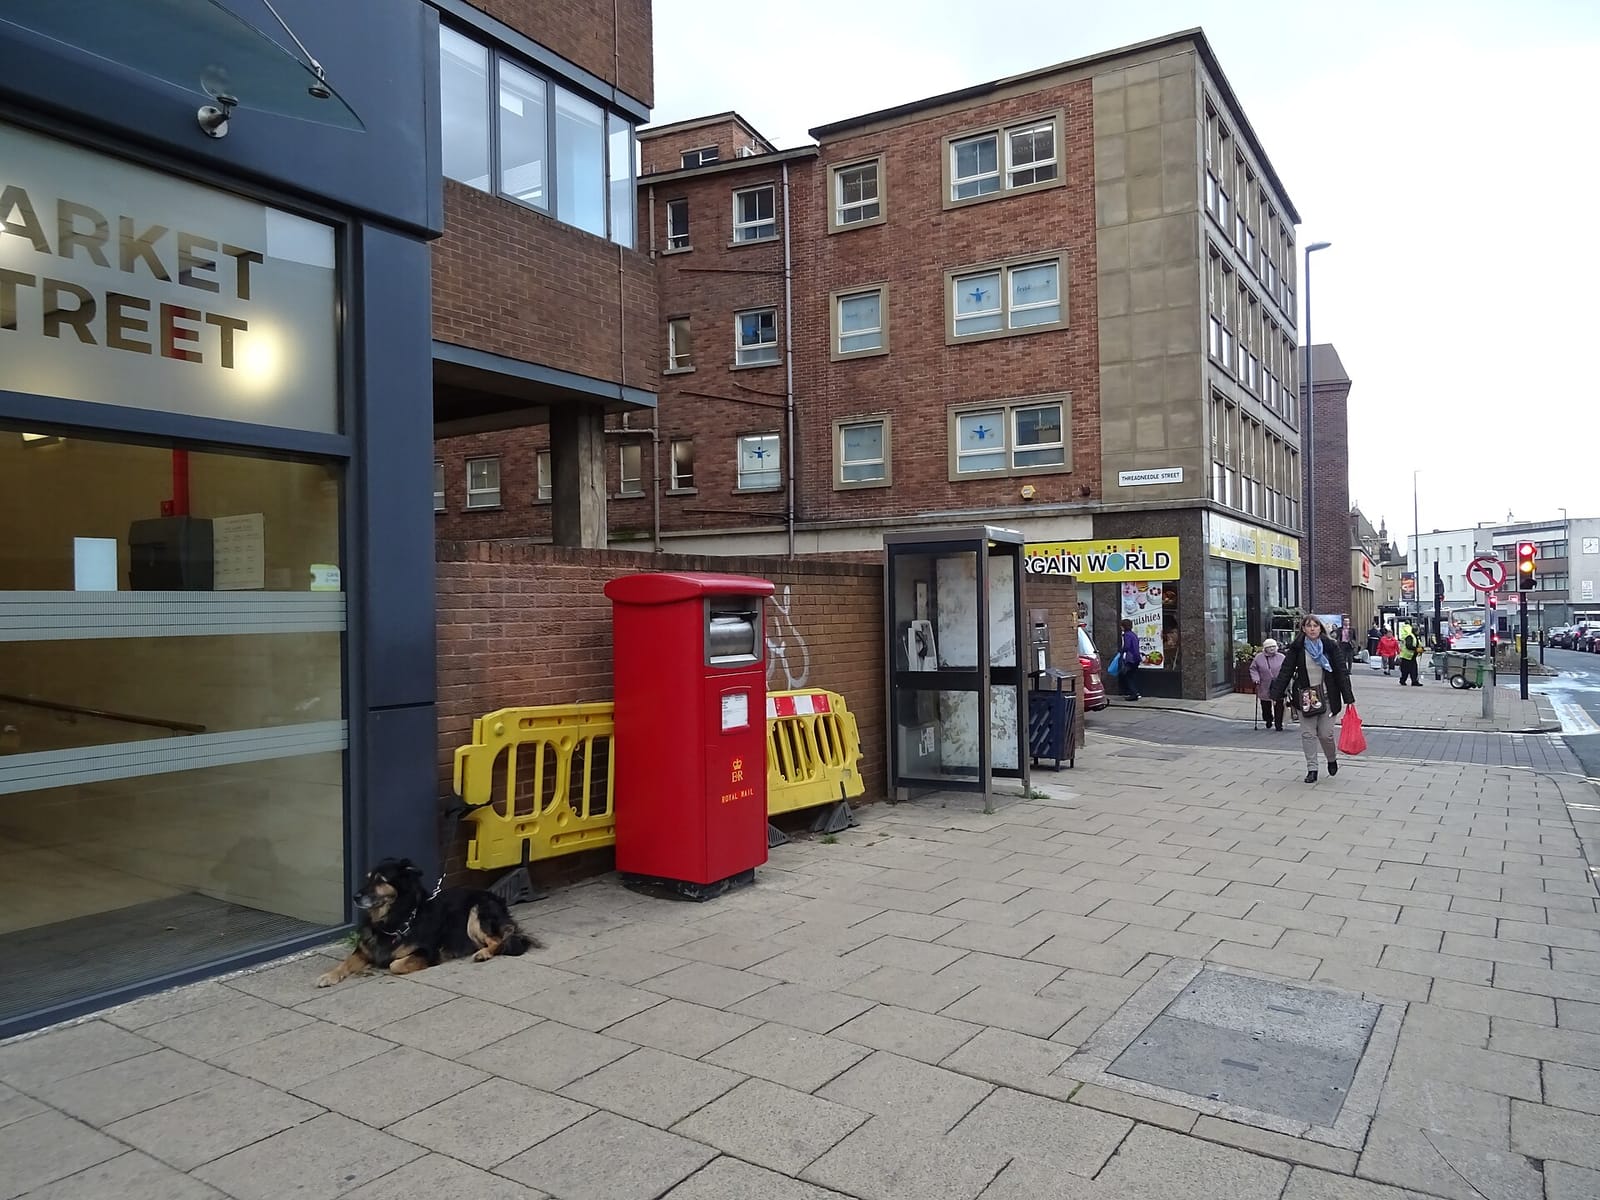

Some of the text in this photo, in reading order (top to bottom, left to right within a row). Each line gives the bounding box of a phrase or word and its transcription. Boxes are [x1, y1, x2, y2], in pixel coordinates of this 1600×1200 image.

[1121, 471, 1180, 481] THREADNEEDLE STREET
[1087, 551, 1170, 572] WORLD
[721, 788, 754, 804] ROYAL MAIL
